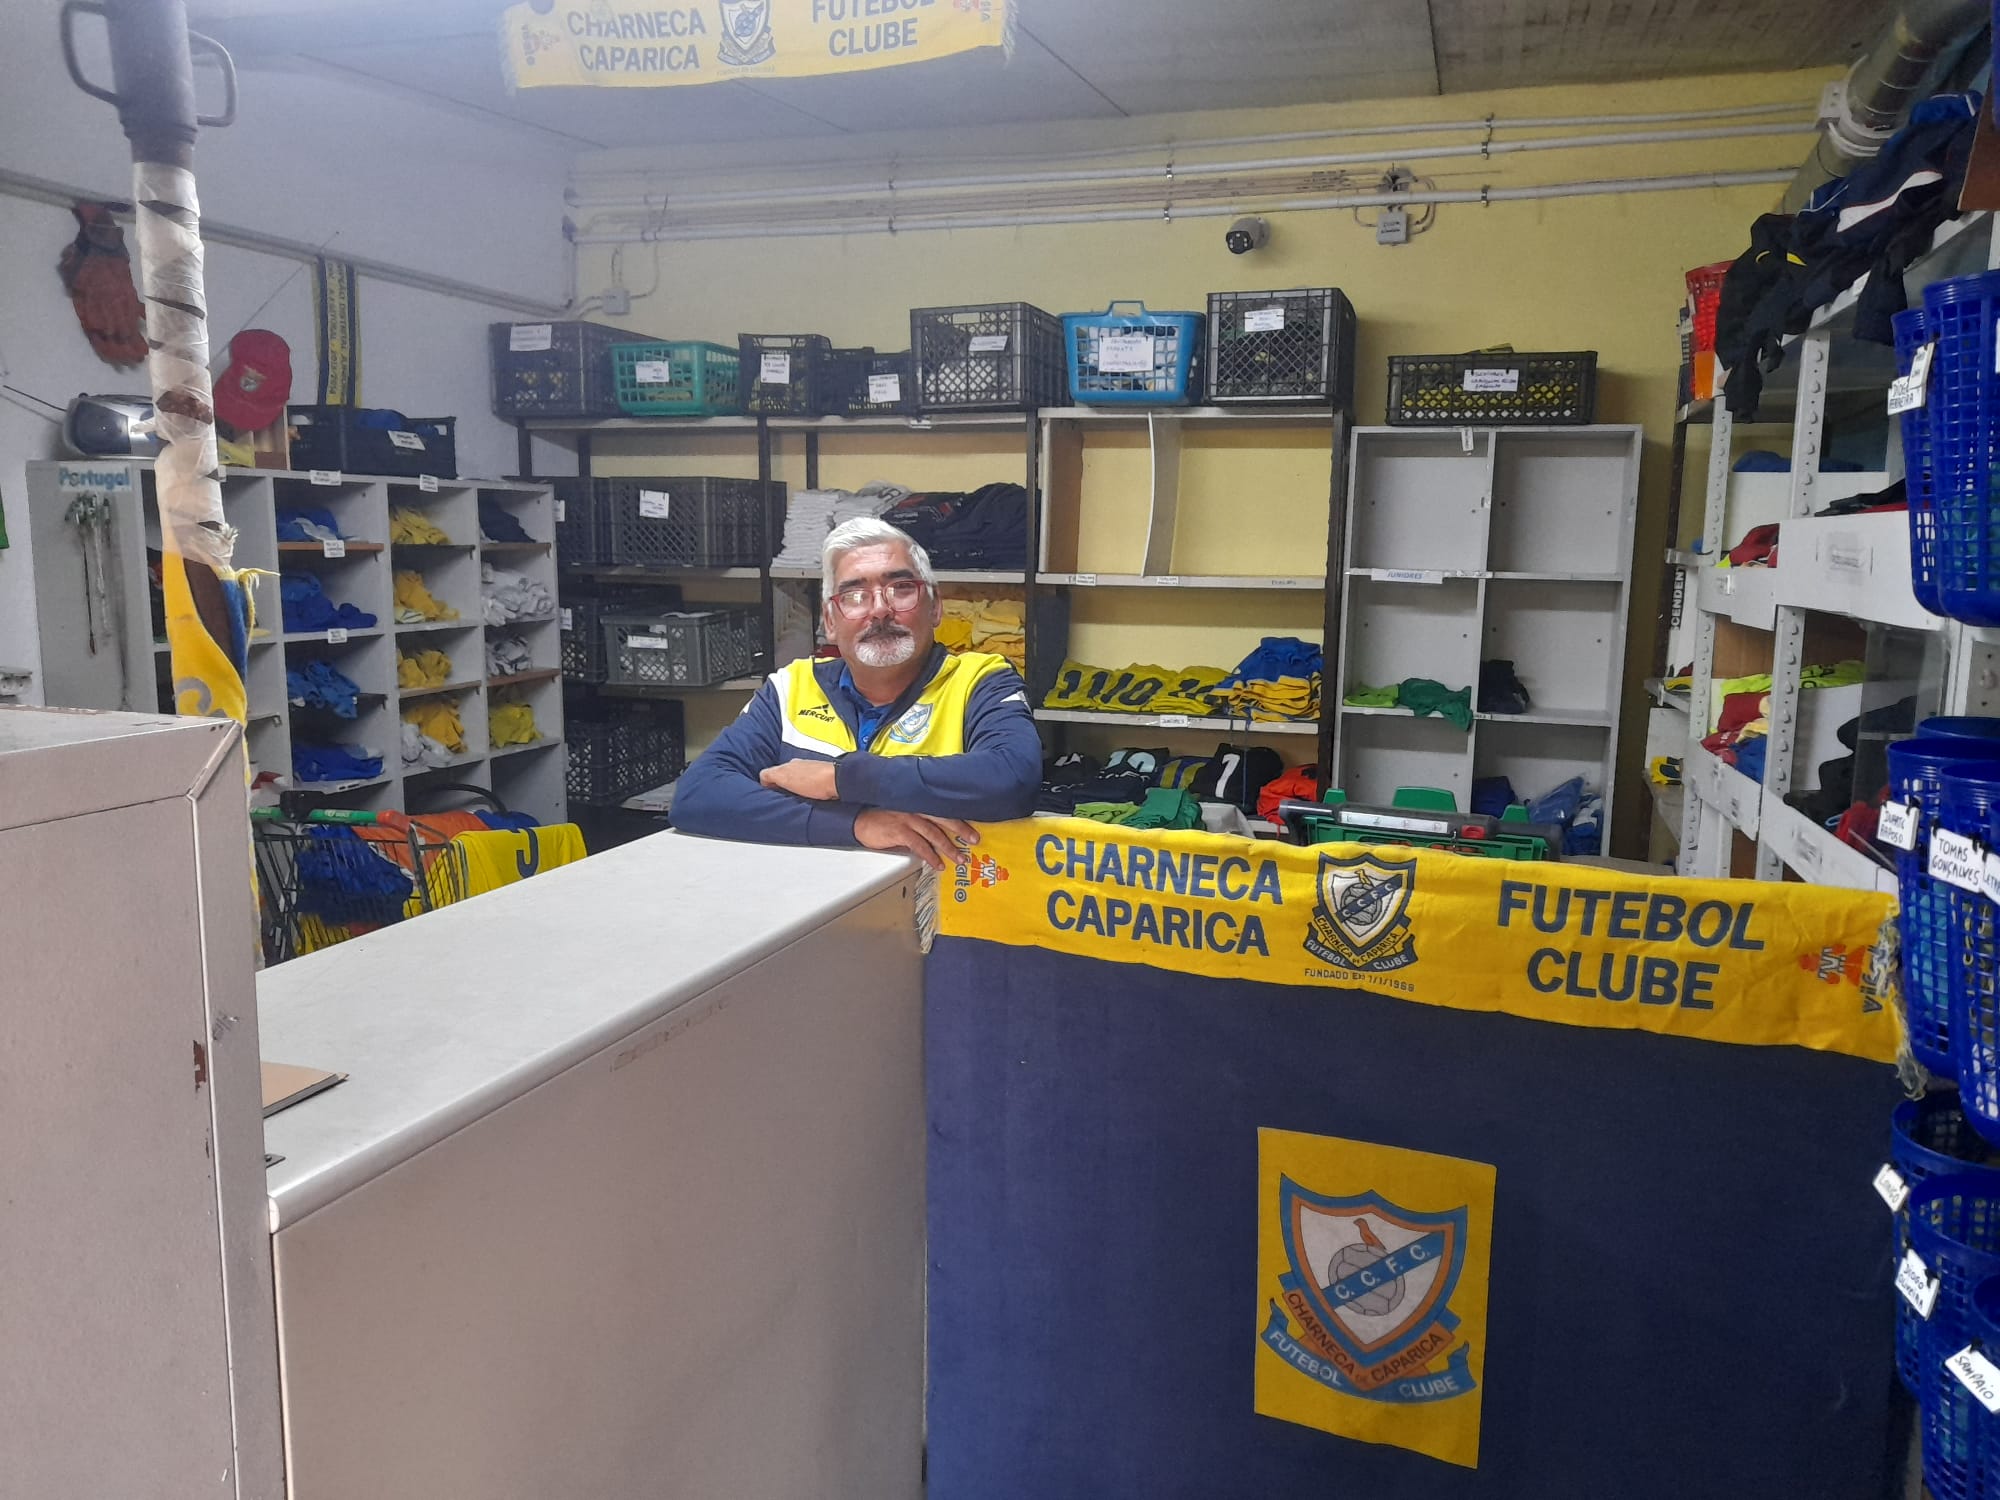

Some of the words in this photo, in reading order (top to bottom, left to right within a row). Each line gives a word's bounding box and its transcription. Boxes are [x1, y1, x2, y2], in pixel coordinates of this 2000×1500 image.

[567, 8, 706, 38] CHARNECA
[828, 18, 918, 57] CLUBE
[580, 44, 700, 71] CAPARICA
[59, 467, 131, 491] Portugal
[1034, 833, 1283, 905] CHARNECA
[1938, 837, 1969, 862] TOMAS
[1046, 889, 1270, 957] CAPARICA
[1497, 879, 1765, 951] FUTEBOL
[1306, 939, 1347, 967] FUTEBOL
[1373, 954, 1409, 970] CLUBE
[1316, 915, 1354, 959] CHARNECA
[1360, 932, 1401, 962] CAPARICA
[1304, 968, 1349, 980] FUNDADO
[1527, 947, 1721, 1010] CLUBE
[1286, 1292, 1356, 1375] CHARNECA
[1370, 1331, 1445, 1383] CAPARICA
[1269, 1330, 1343, 1386] FUTEBOL
[1399, 1375, 1459, 1398] CLUBE
